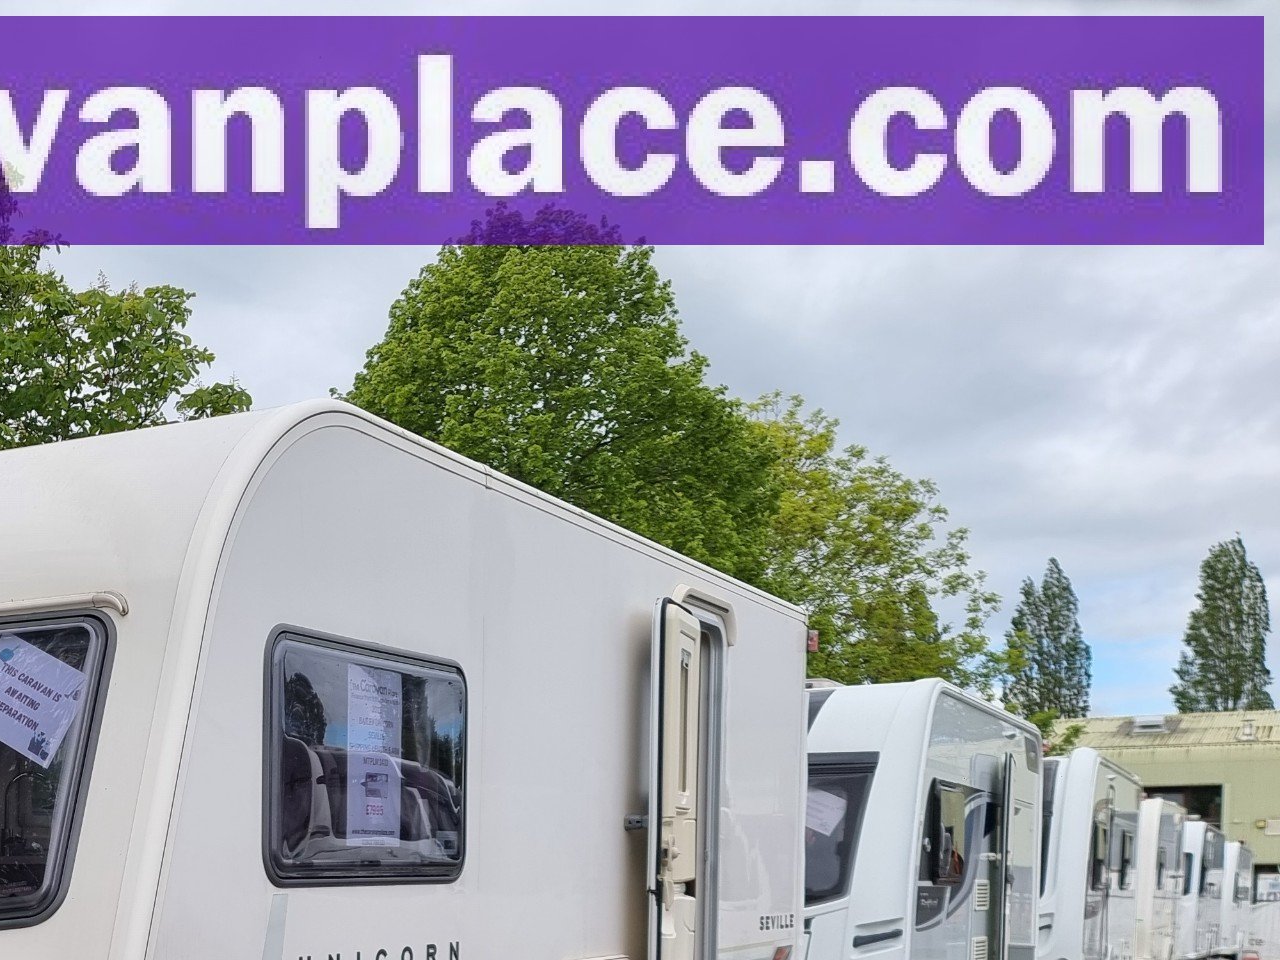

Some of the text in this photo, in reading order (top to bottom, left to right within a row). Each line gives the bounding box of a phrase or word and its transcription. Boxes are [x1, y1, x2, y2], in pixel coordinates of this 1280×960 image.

[1, 662, 63, 703] THIS CARAVAN IS
[4, 686, 41, 711] AWAITING
[760, 913, 794, 931] SEVILLE
